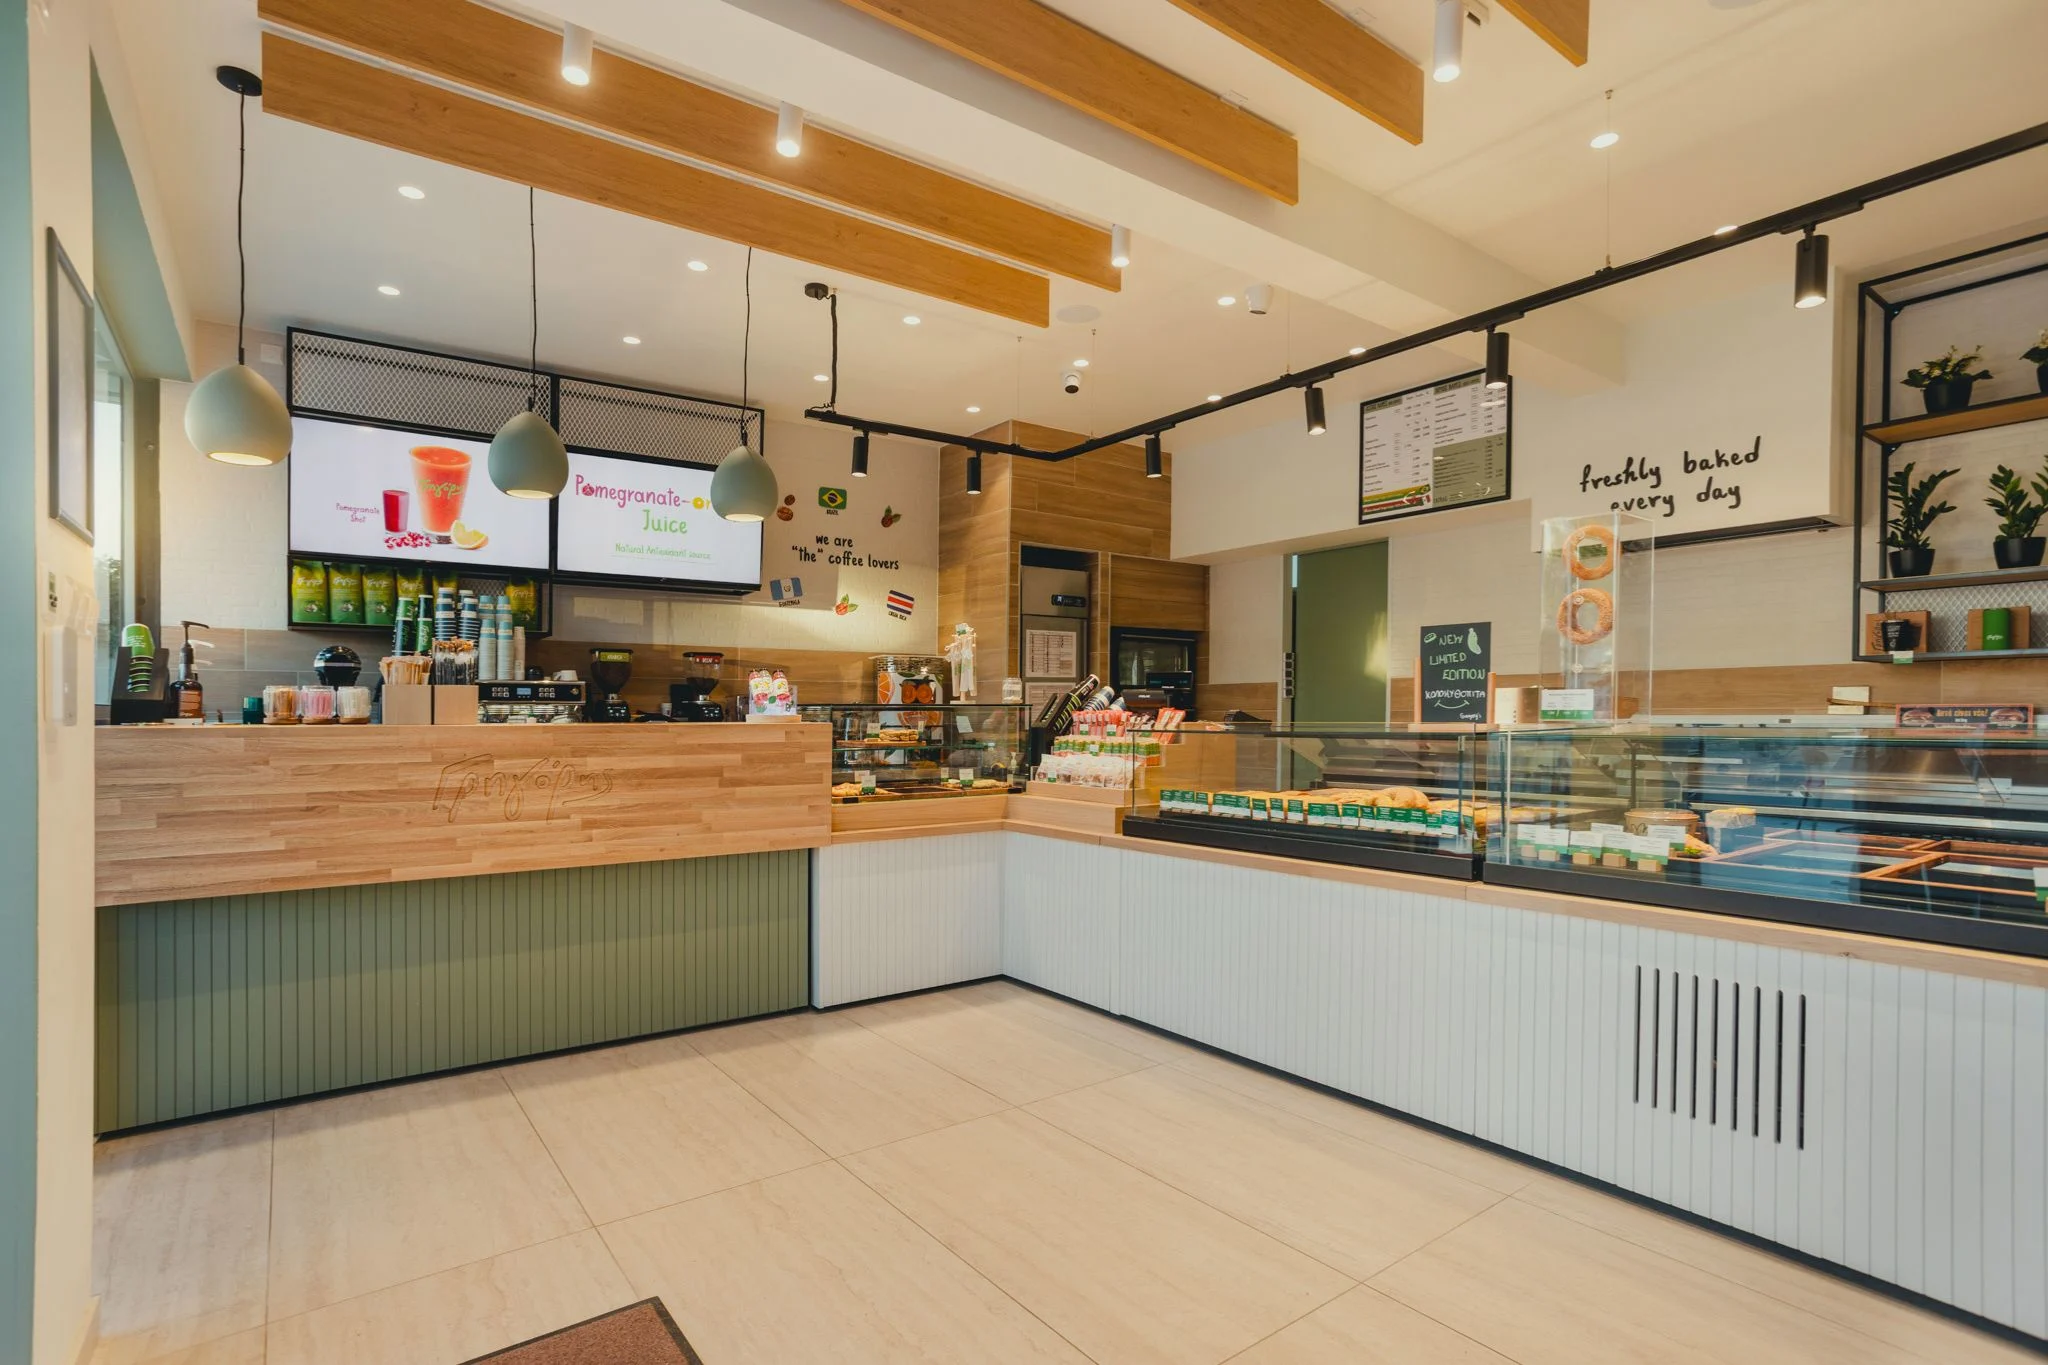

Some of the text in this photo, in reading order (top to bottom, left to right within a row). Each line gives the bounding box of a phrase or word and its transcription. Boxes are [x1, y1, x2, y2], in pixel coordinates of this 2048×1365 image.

[1579, 435, 1761, 493] freshly baked
[1610, 476, 1741, 517] every day
[642, 509, 688, 534] Juice
[815, 535, 854, 548] we are
[615, 543, 644, 555] Natural
[828, 550, 864, 567] coffee
[868, 553, 900, 570] lovers
[1438, 634, 1463, 646] NEW
[1429, 652, 1467, 666] LIMITED
[1442, 668, 1486, 681] EDITION
